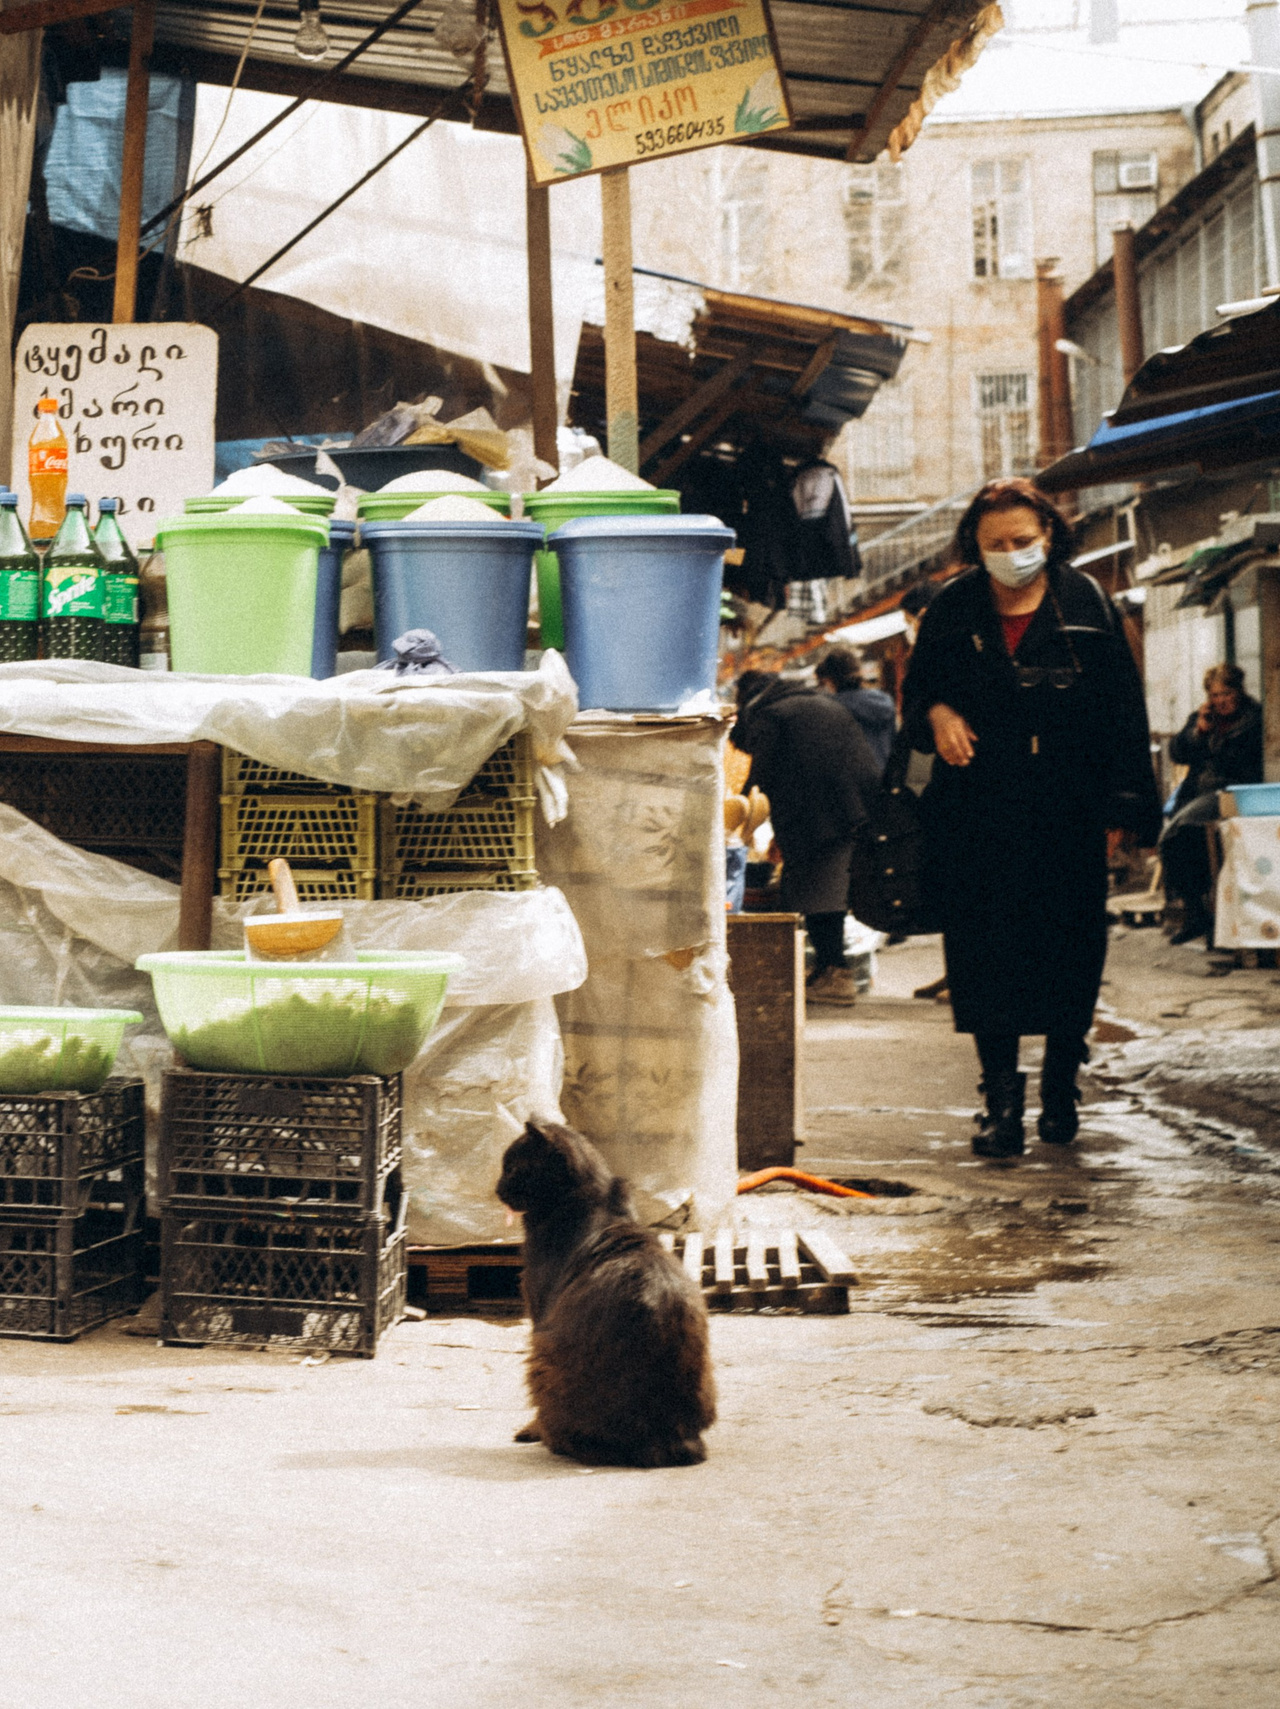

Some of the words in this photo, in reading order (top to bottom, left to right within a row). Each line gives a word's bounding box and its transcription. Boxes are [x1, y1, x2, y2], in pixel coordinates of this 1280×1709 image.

[549, 41, 635, 82] წყალზე
[641, 14, 740, 56] დაფქვილი
[534, 66, 638, 114] საუკეთესო
[585, 84, 699, 139] ელიკო
[635, 116, 725, 153] 593660435
[24, 327, 188, 382] ტყემალი
